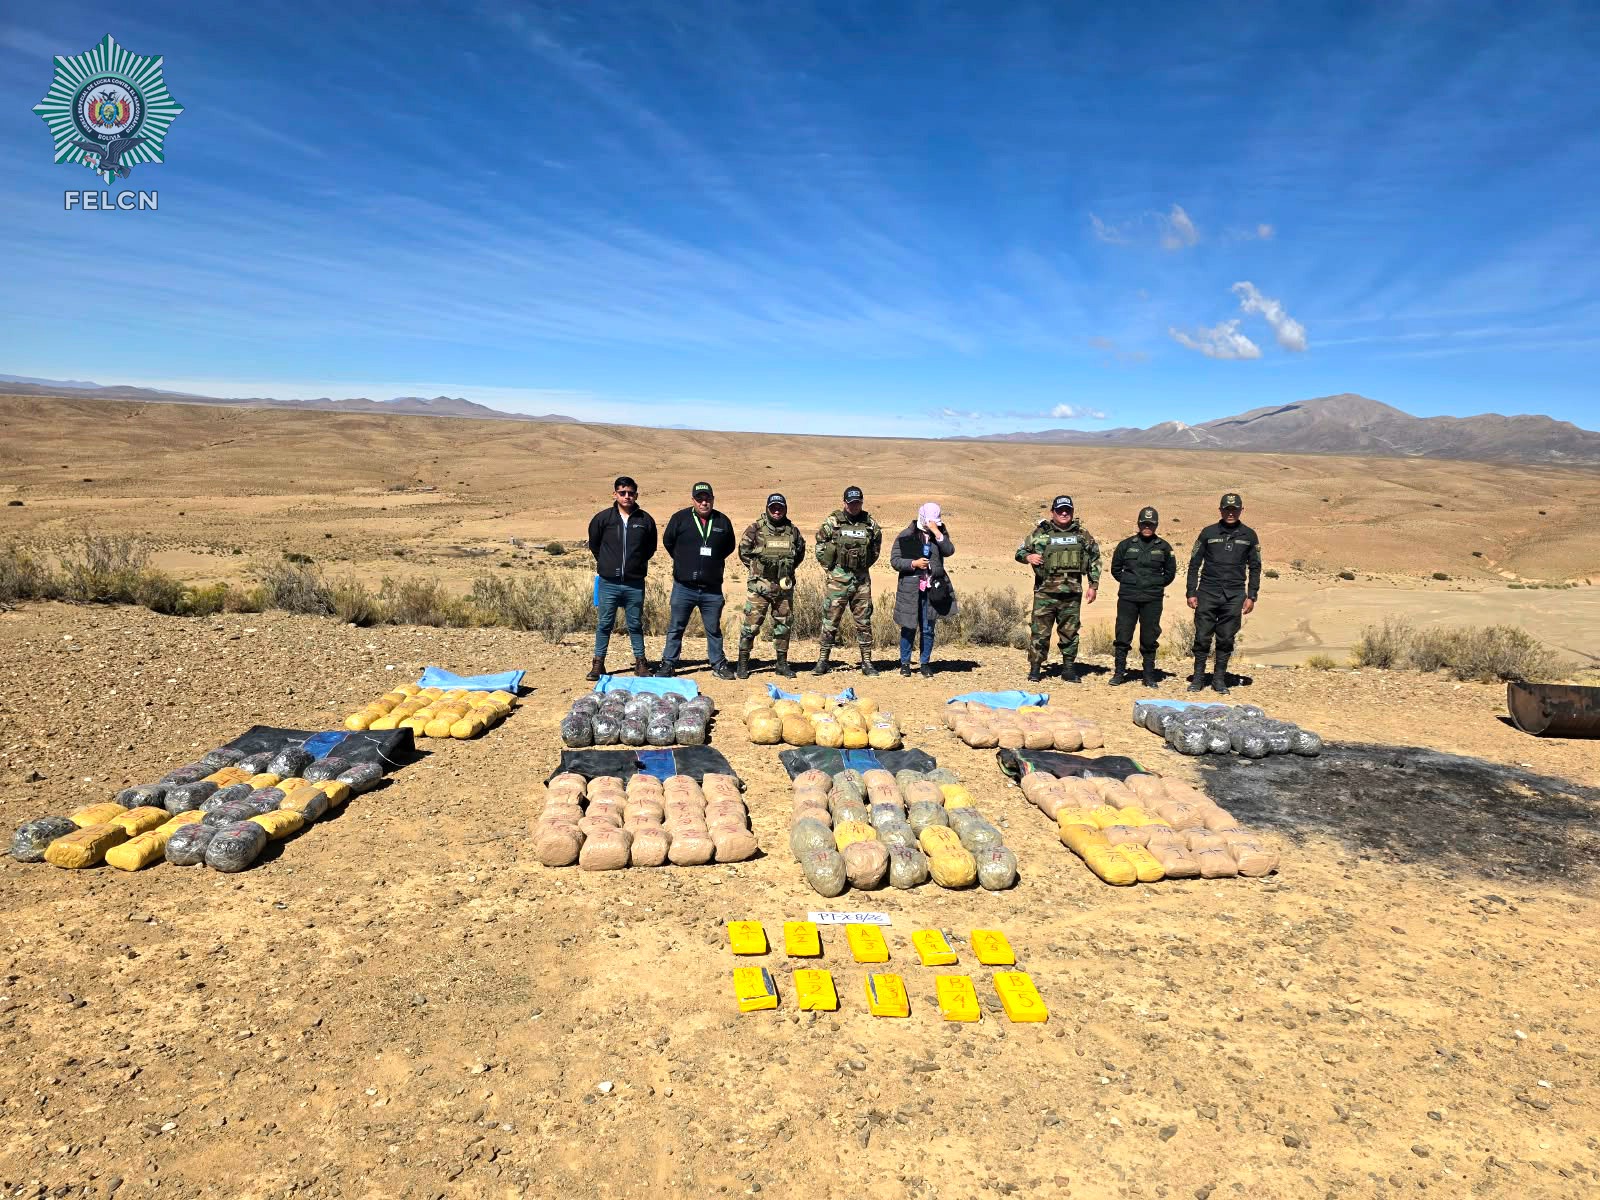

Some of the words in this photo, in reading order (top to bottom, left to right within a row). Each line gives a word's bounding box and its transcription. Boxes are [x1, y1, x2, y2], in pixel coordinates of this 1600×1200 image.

[950, 978, 964, 989] B
[1009, 975, 1024, 986] B
[952, 994, 965, 1008] 4
[1018, 993, 1034, 1008] 5
